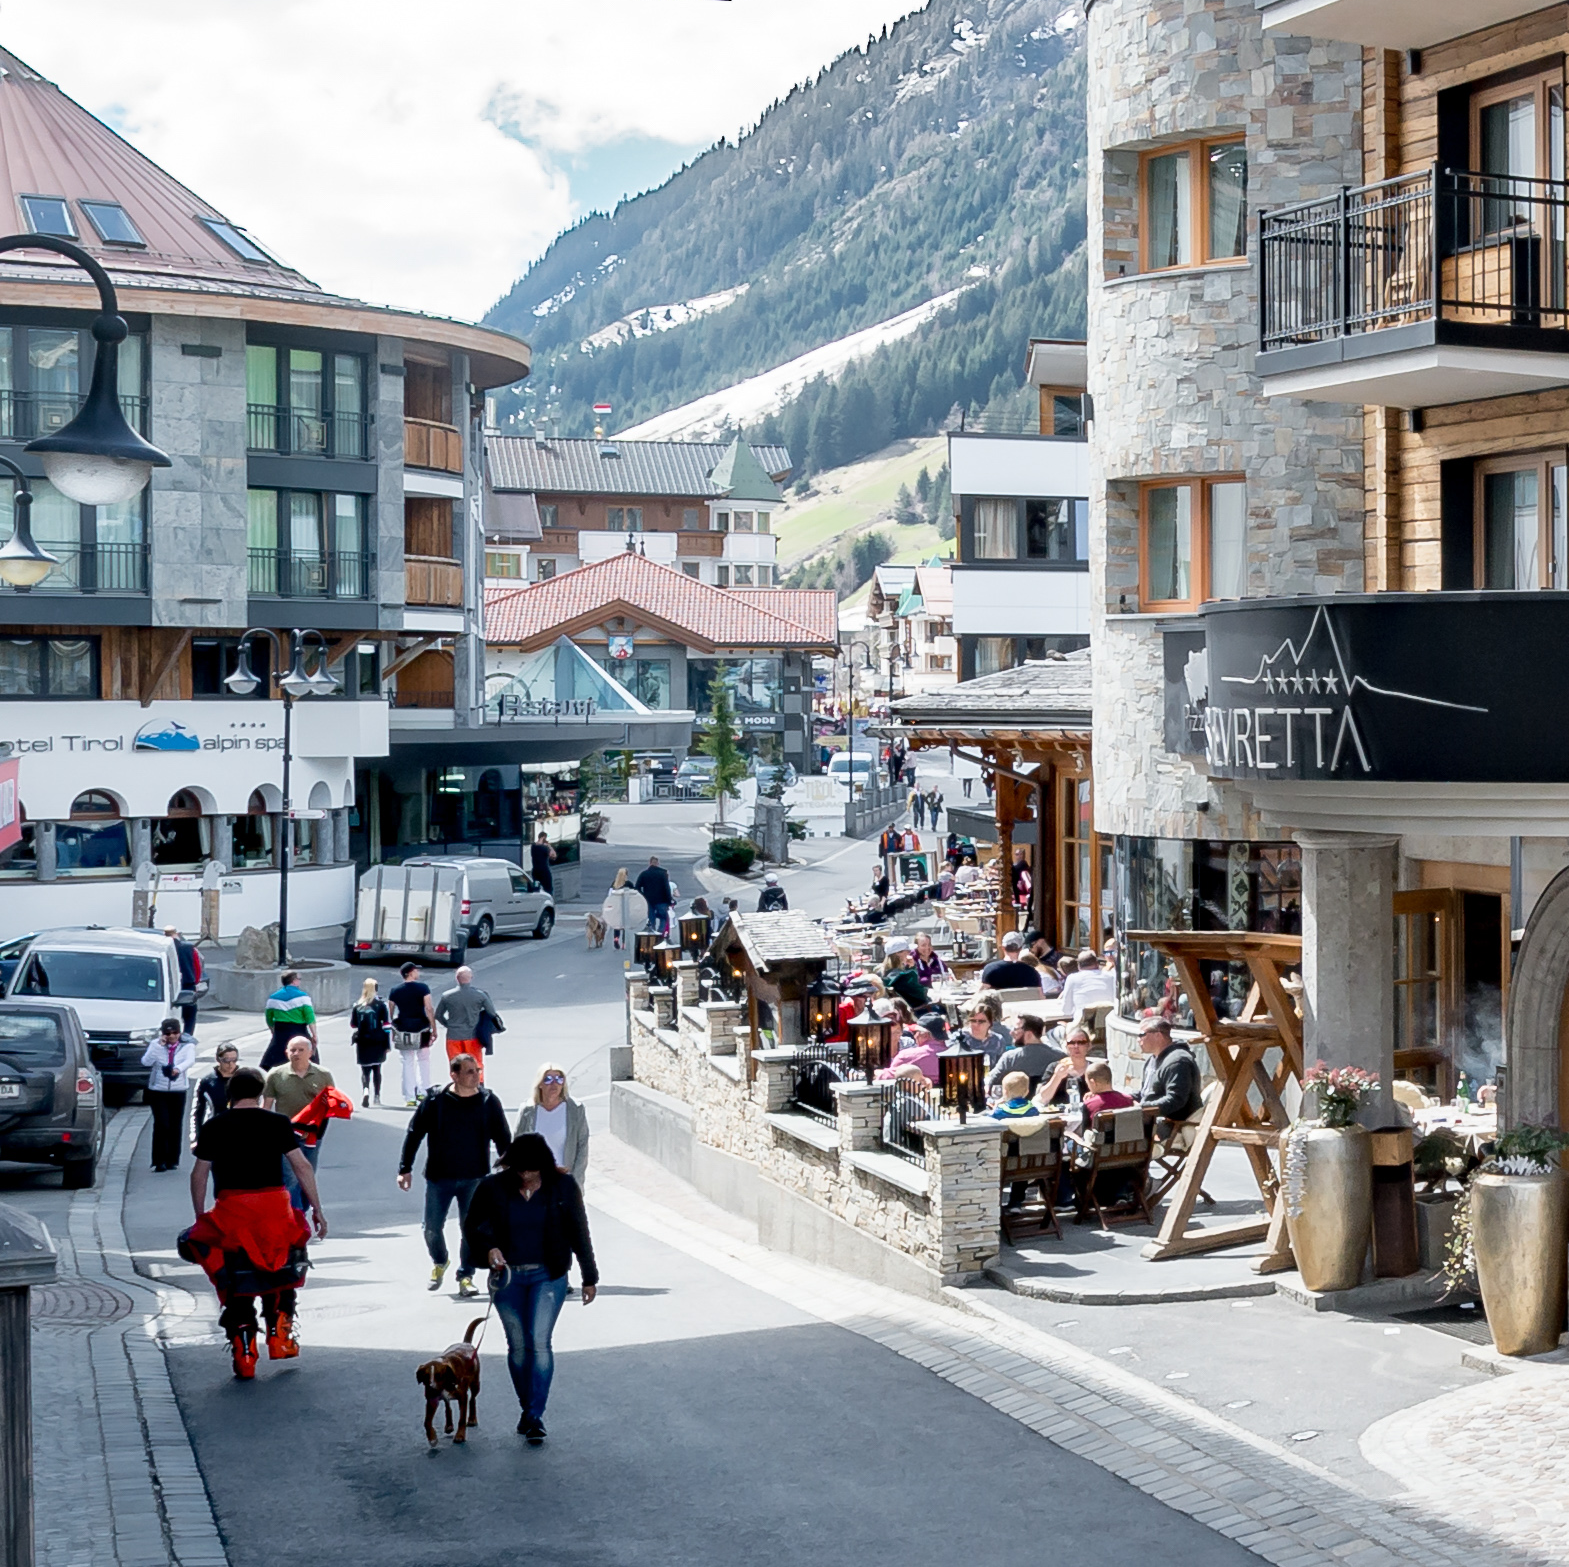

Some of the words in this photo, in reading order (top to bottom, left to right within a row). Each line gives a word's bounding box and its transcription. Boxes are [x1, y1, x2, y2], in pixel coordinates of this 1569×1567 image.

[744, 716, 776, 725] MODE
[0, 736, 53, 753] otel
[61, 735, 124, 752] Tirol
[203, 737, 250, 753] alpin
[254, 736, 286, 752] spa
